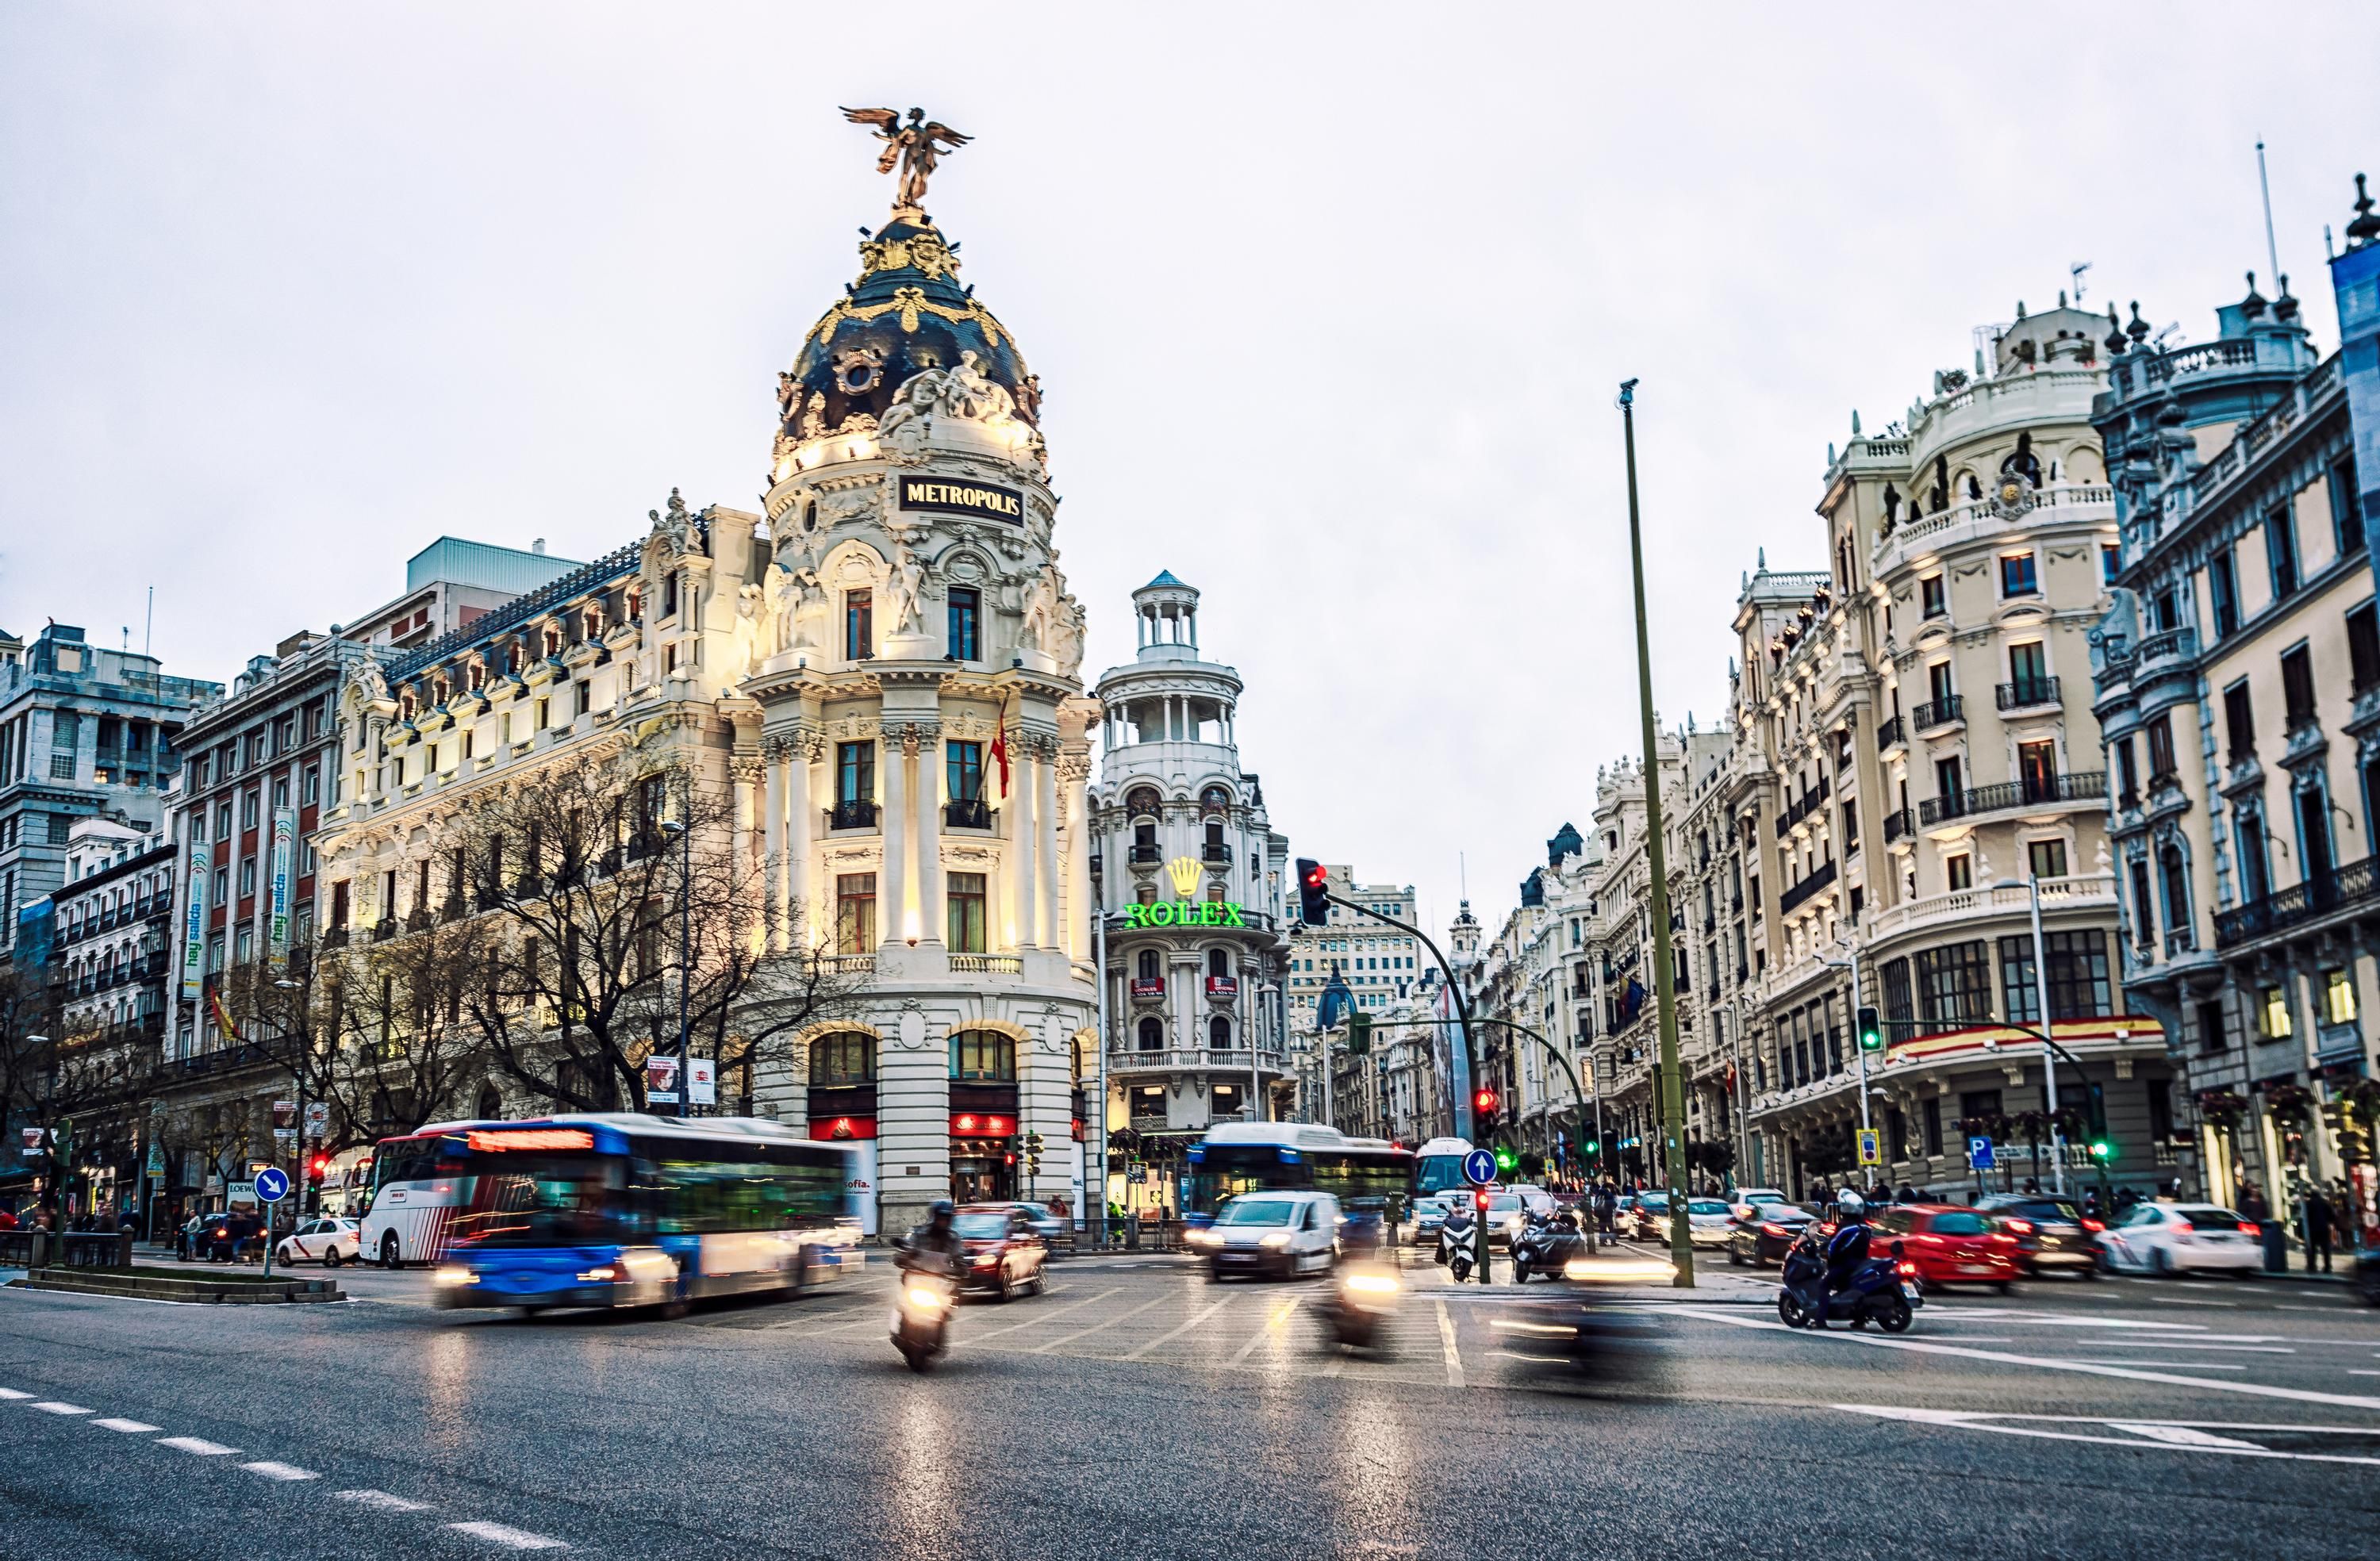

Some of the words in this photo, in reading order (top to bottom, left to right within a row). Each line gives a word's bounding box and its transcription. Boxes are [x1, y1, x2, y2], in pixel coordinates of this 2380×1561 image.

[907, 483, 1020, 516] METROPOLIS
[274, 873, 286, 913] salida
[188, 903, 201, 941] salida
[1123, 900, 1246, 928] ROLEX
[271, 915, 287, 942] hay
[186, 942, 202, 967] hay
[1972, 1139, 1985, 1156] P
